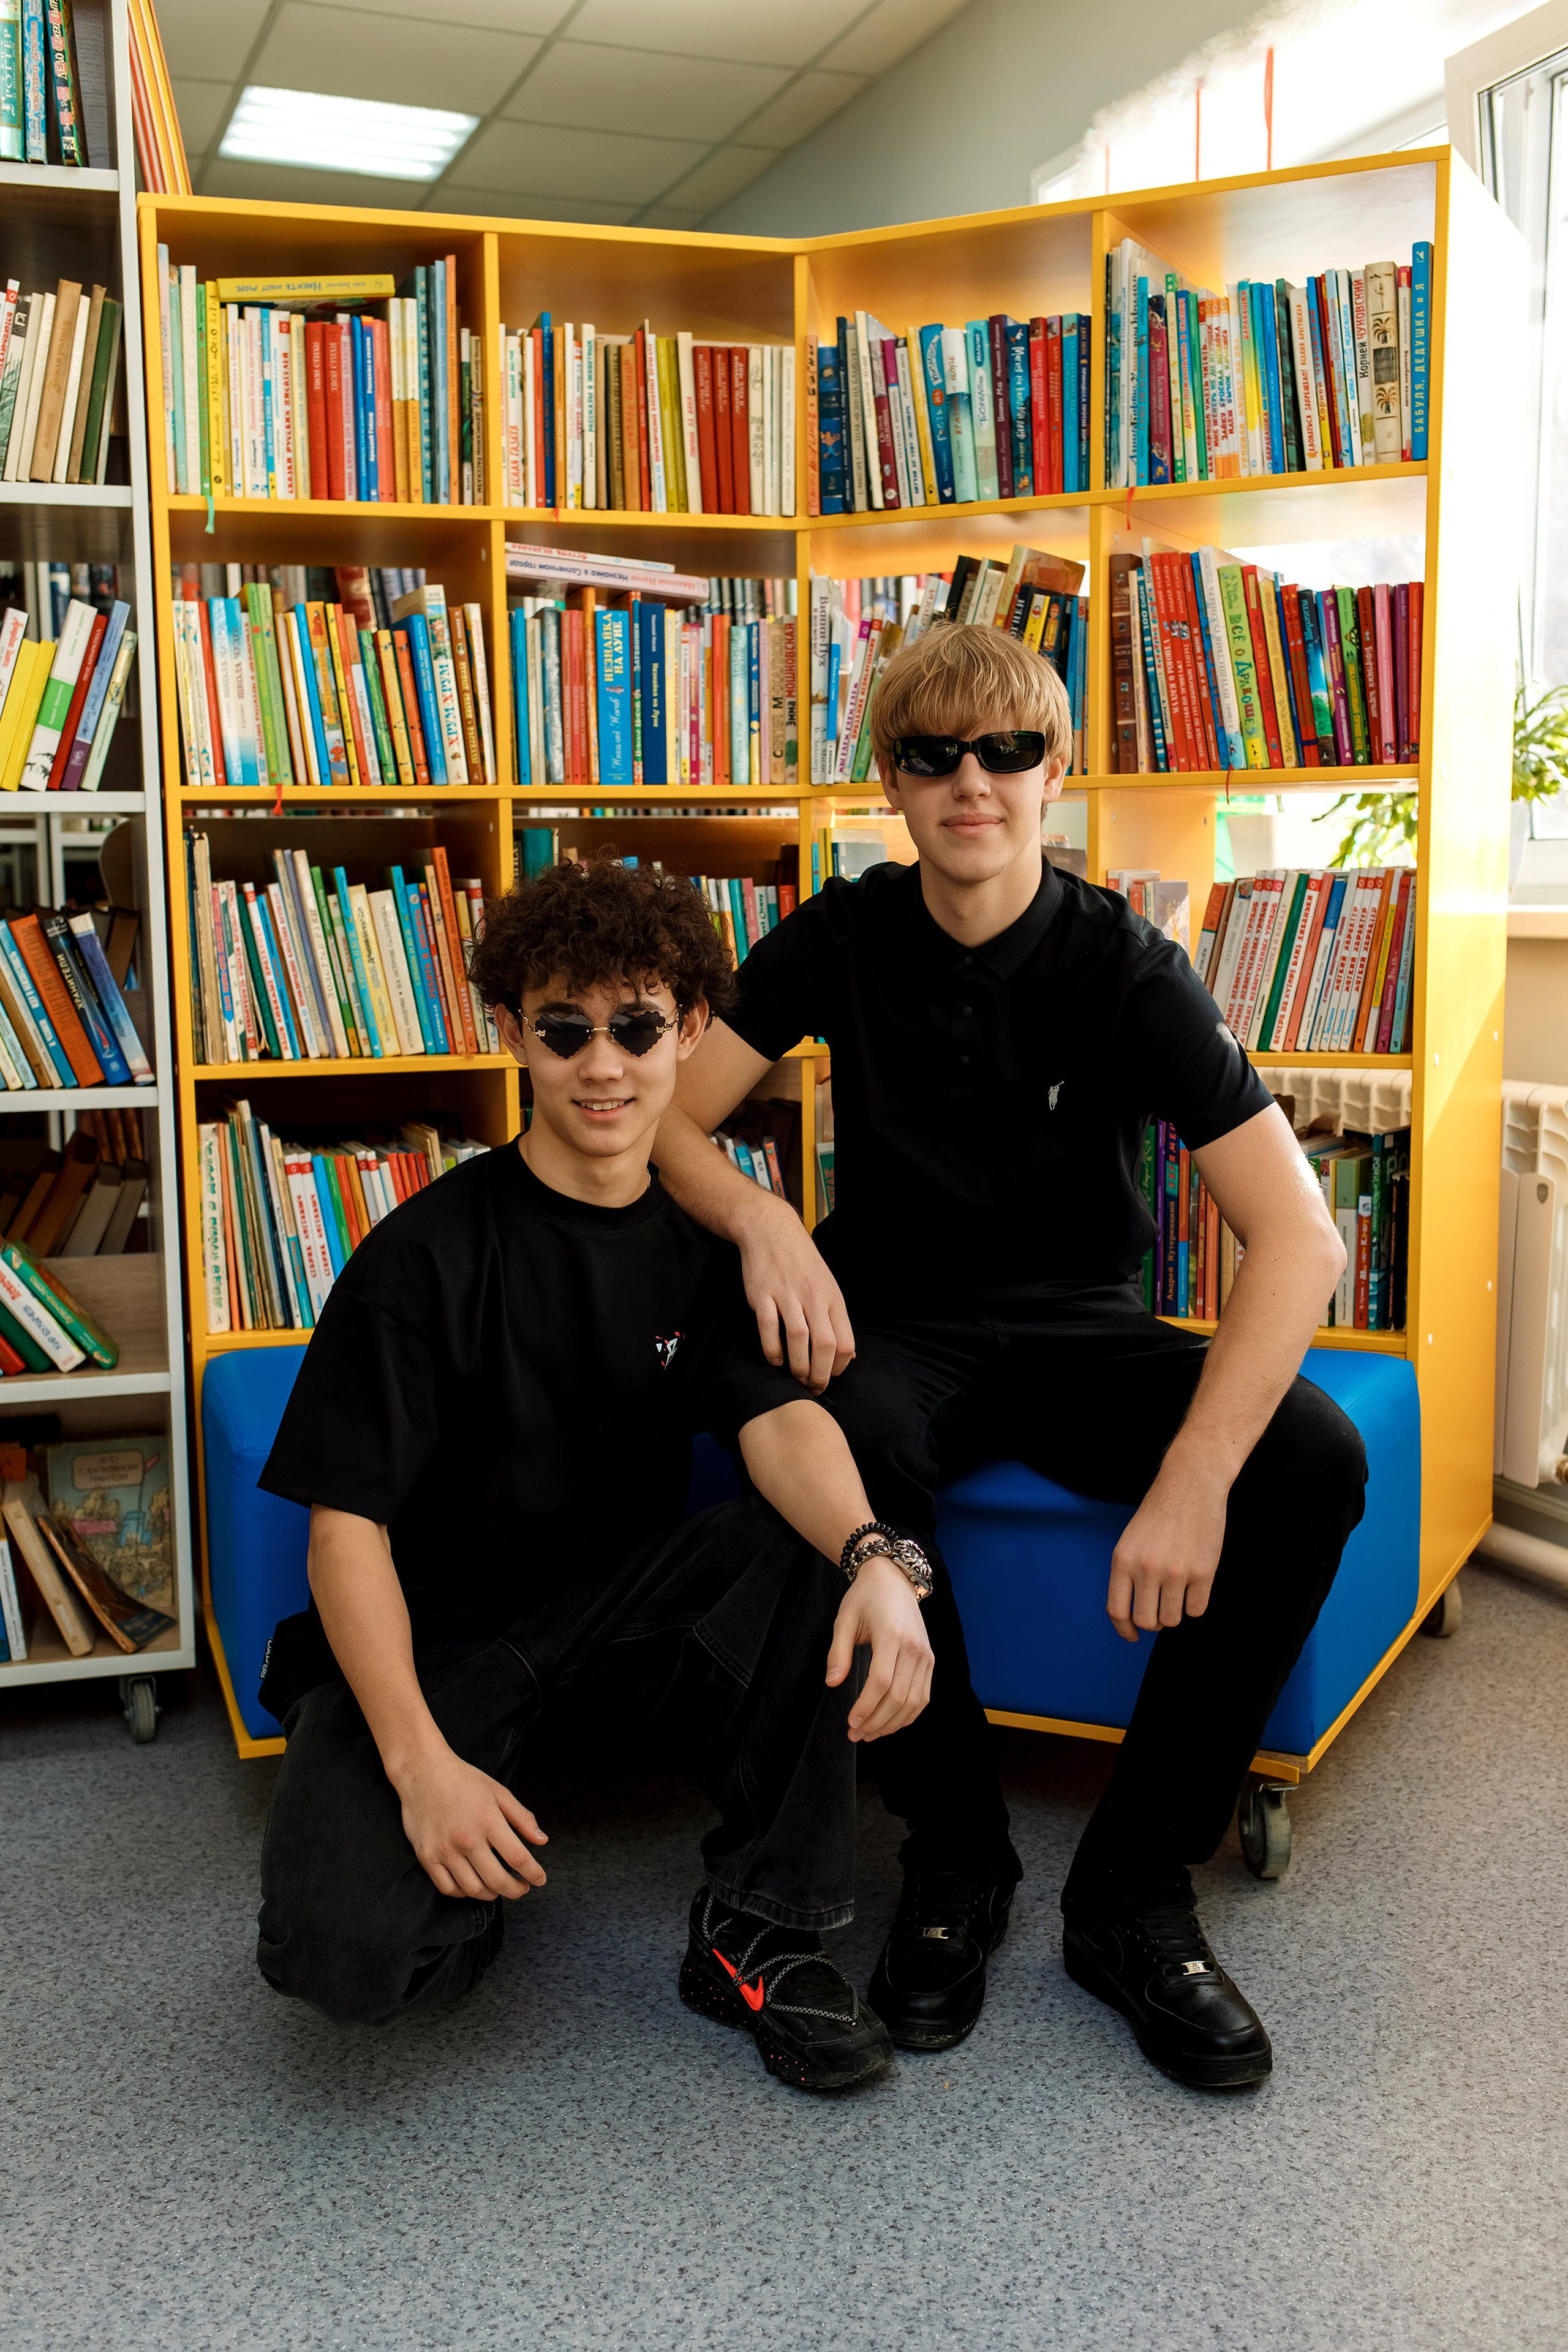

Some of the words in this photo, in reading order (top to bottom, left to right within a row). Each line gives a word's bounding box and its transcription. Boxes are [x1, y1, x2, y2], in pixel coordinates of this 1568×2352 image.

[55, 53, 67, 80] ДЕЛО
[1240, 290, 1250, 339] БАРАБАШКА
[1352, 279, 1365, 339] ЧУКОВСКИЙ
[1308, 309, 1321, 379] ЧУКОВСКИЙ
[1357, 342, 1370, 378] Корней
[1415, 310, 1425, 372] ДЕДУШКА
[1317, 382, 1327, 421] Корней
[1414, 379, 1426, 433] БАБУЛЯ,
[1263, 412, 1272, 461] БАРАБАШКА
[602, 613, 613, 681] НЕЗНАЙКА
[613, 621, 623, 654] ЛУНЕ
[816, 596, 829, 667] Винни-Пух
[614, 657, 623, 674] НА
[785, 623, 796, 698] МОШКОВСКАЯ
[439, 664, 453, 704] ХРУМ
[850, 683, 859, 706] ЕДЕМ
[1235, 662, 1254, 724] ДРАКОШЕ
[445, 707, 459, 747] ХРУМ
[841, 734, 850, 756] ЕДЕМ
[838, 758, 845, 773] МЫ
[415, 909, 426, 949] ЗВЕРЯТА
[1297, 895, 1313, 941] ДИКАНЬКИ
[1230, 938, 1250, 1000] НЕВЫУЧЕННЫХ
[1246, 901, 1259, 934] УРОКОВ
[1232, 1003, 1243, 1033] СТРАНЕ
[1238, 938, 1259, 1000] НЕВЫУЧЕННЫХ
[1255, 902, 1268, 934] УРОКОВ
[1242, 1005, 1255, 1035] СТРАНЕ
[1250, 938, 1268, 1001] НЕВЫУЧЕННЫХ
[1264, 902, 1278, 935] УРОКОВ
[1291, 944, 1302, 966] БЛИЗ
[1334, 956, 1346, 992] МЯГКИЙ
[1343, 907, 1358, 951] ХАРАКТЕР
[1344, 957, 1356, 992] МЯГКИЙ
[1353, 907, 1367, 952] ХАРАКТЕР
[1354, 957, 1366, 992] МЯГКИЙ
[1363, 907, 1377, 952] ХАРАКТЕР
[56, 953, 85, 1009] ХРАНИТЕЛИ
[425, 963, 436, 998] РЕБЯТА
[1283, 969, 1297, 999] ХУТОРЕ
[1281, 1001, 1289, 1012] НА
[1273, 1014, 1286, 1044] ВЕЧЕРА
[296, 1195, 309, 1239] ХОТТАБЫЧ
[311, 1194, 323, 1238] ХОТТАБЫЧ
[305, 1245, 317, 1278] СТАРИК
[318, 1244, 330, 1276] СТАРИК
